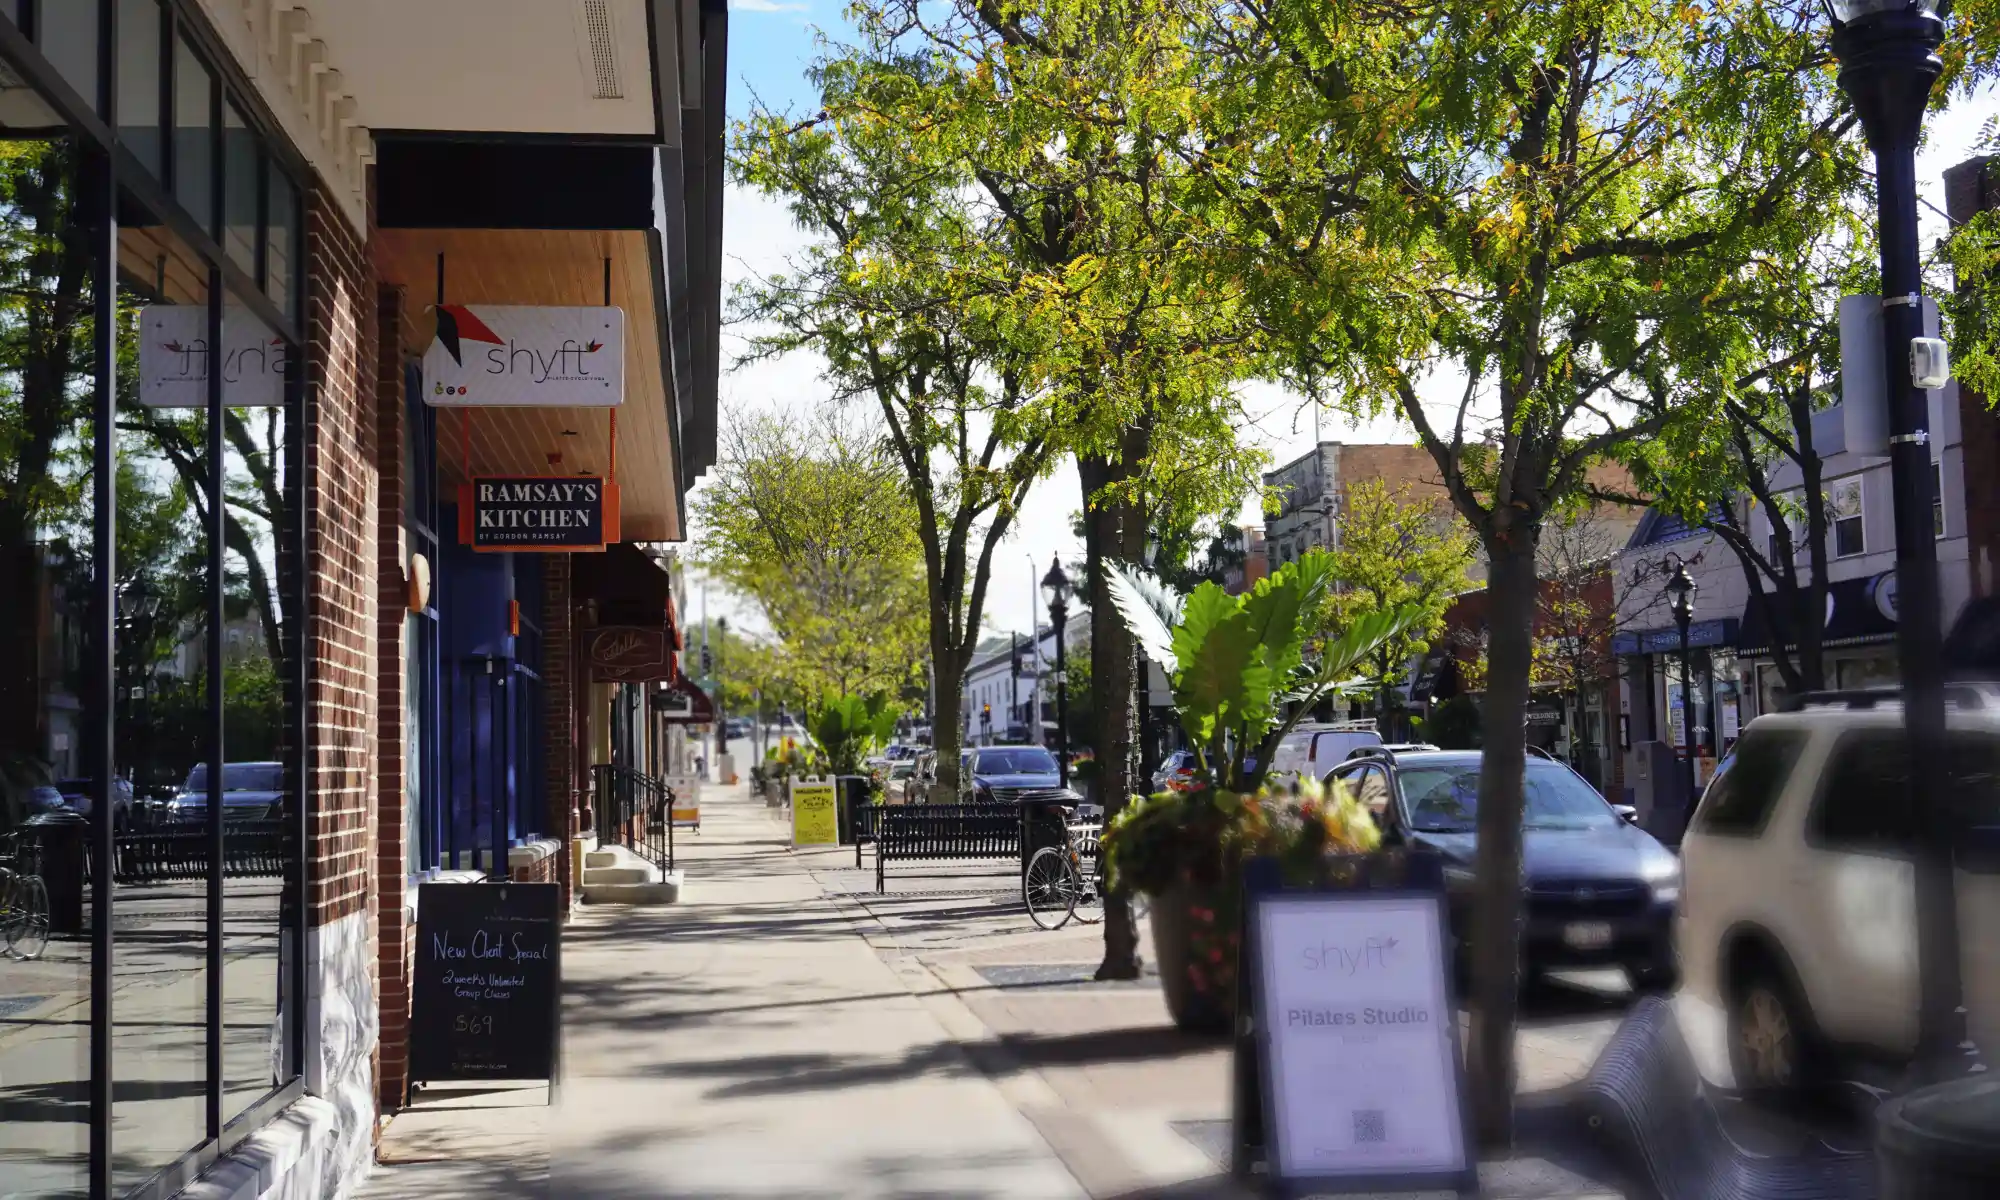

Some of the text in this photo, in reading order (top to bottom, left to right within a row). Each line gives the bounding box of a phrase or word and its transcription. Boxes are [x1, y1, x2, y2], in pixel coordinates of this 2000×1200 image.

[486, 338, 593, 383] shyft
[480, 484, 597, 502] RAMSAY'S
[479, 509, 590, 527] KITCHEN
[433, 931, 466, 960] New
[1302, 937, 1388, 977] shyft
[1287, 1006, 1429, 1027] Pilates Studio
